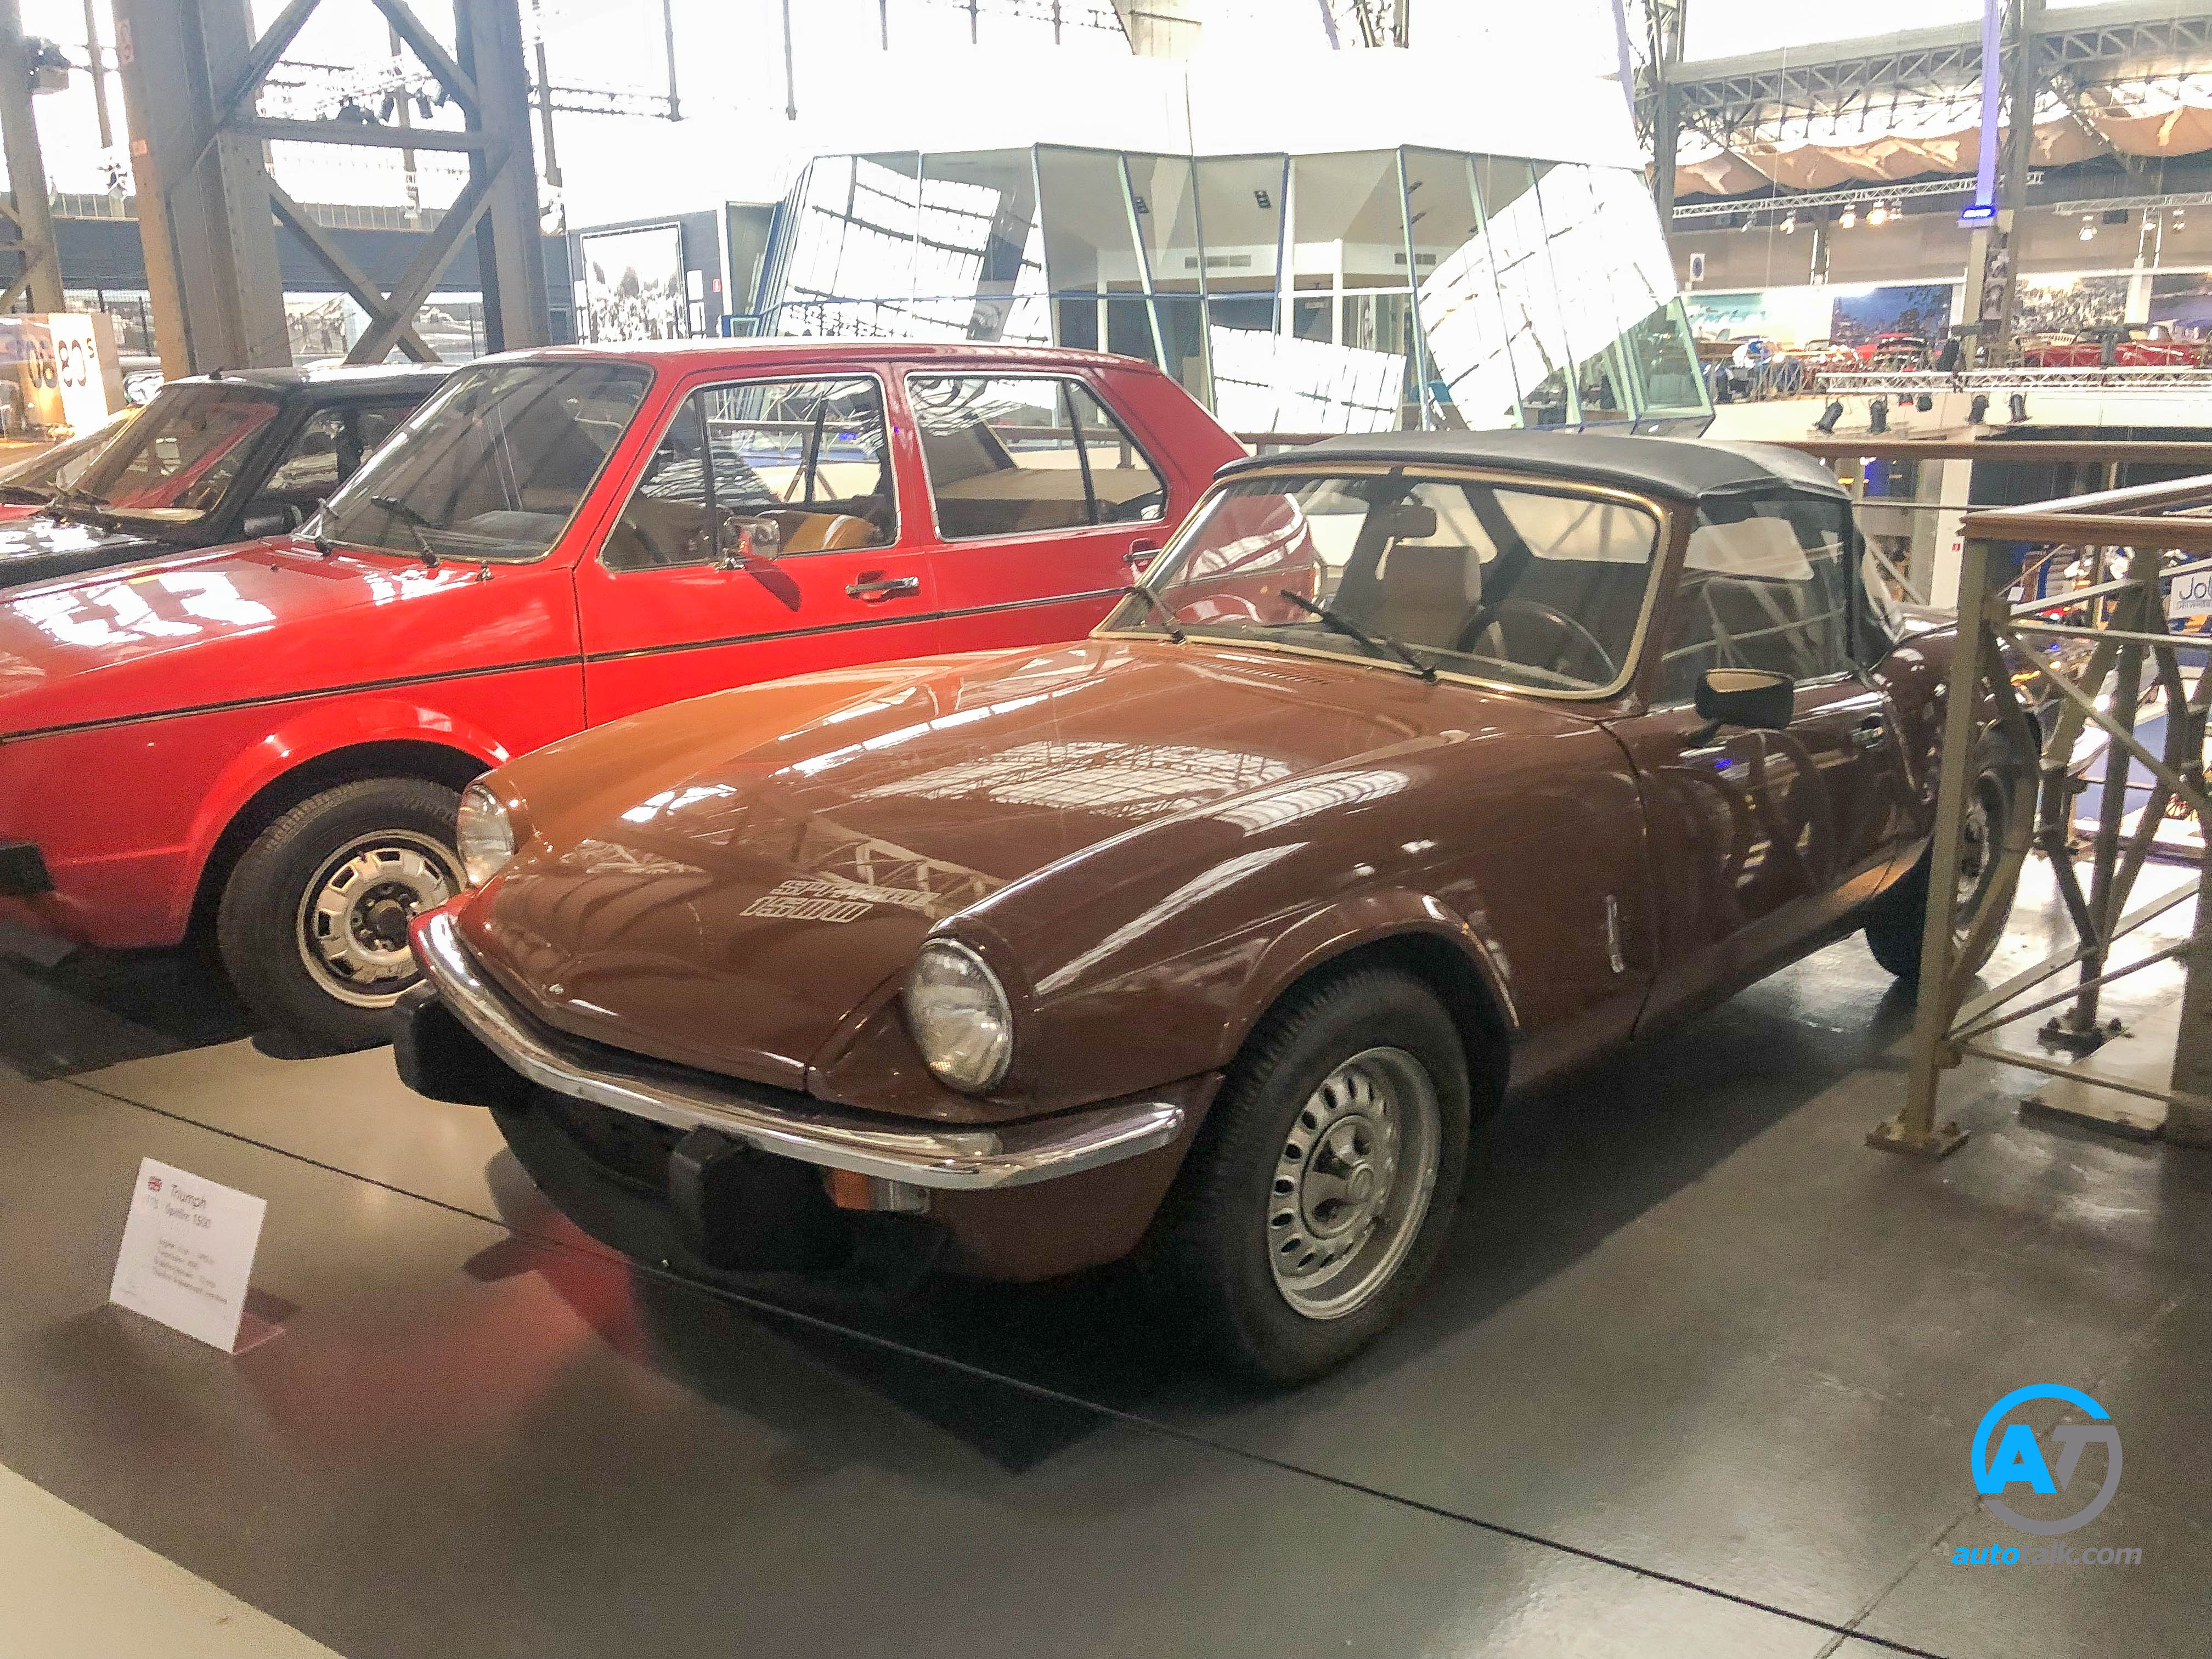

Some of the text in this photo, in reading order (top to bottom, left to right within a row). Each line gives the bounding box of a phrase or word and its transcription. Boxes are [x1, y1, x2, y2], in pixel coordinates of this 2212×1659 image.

[2178, 576, 2212, 600] Jo
[738, 896, 873, 923] 1500
[171, 1184, 206, 1210] Triumph
